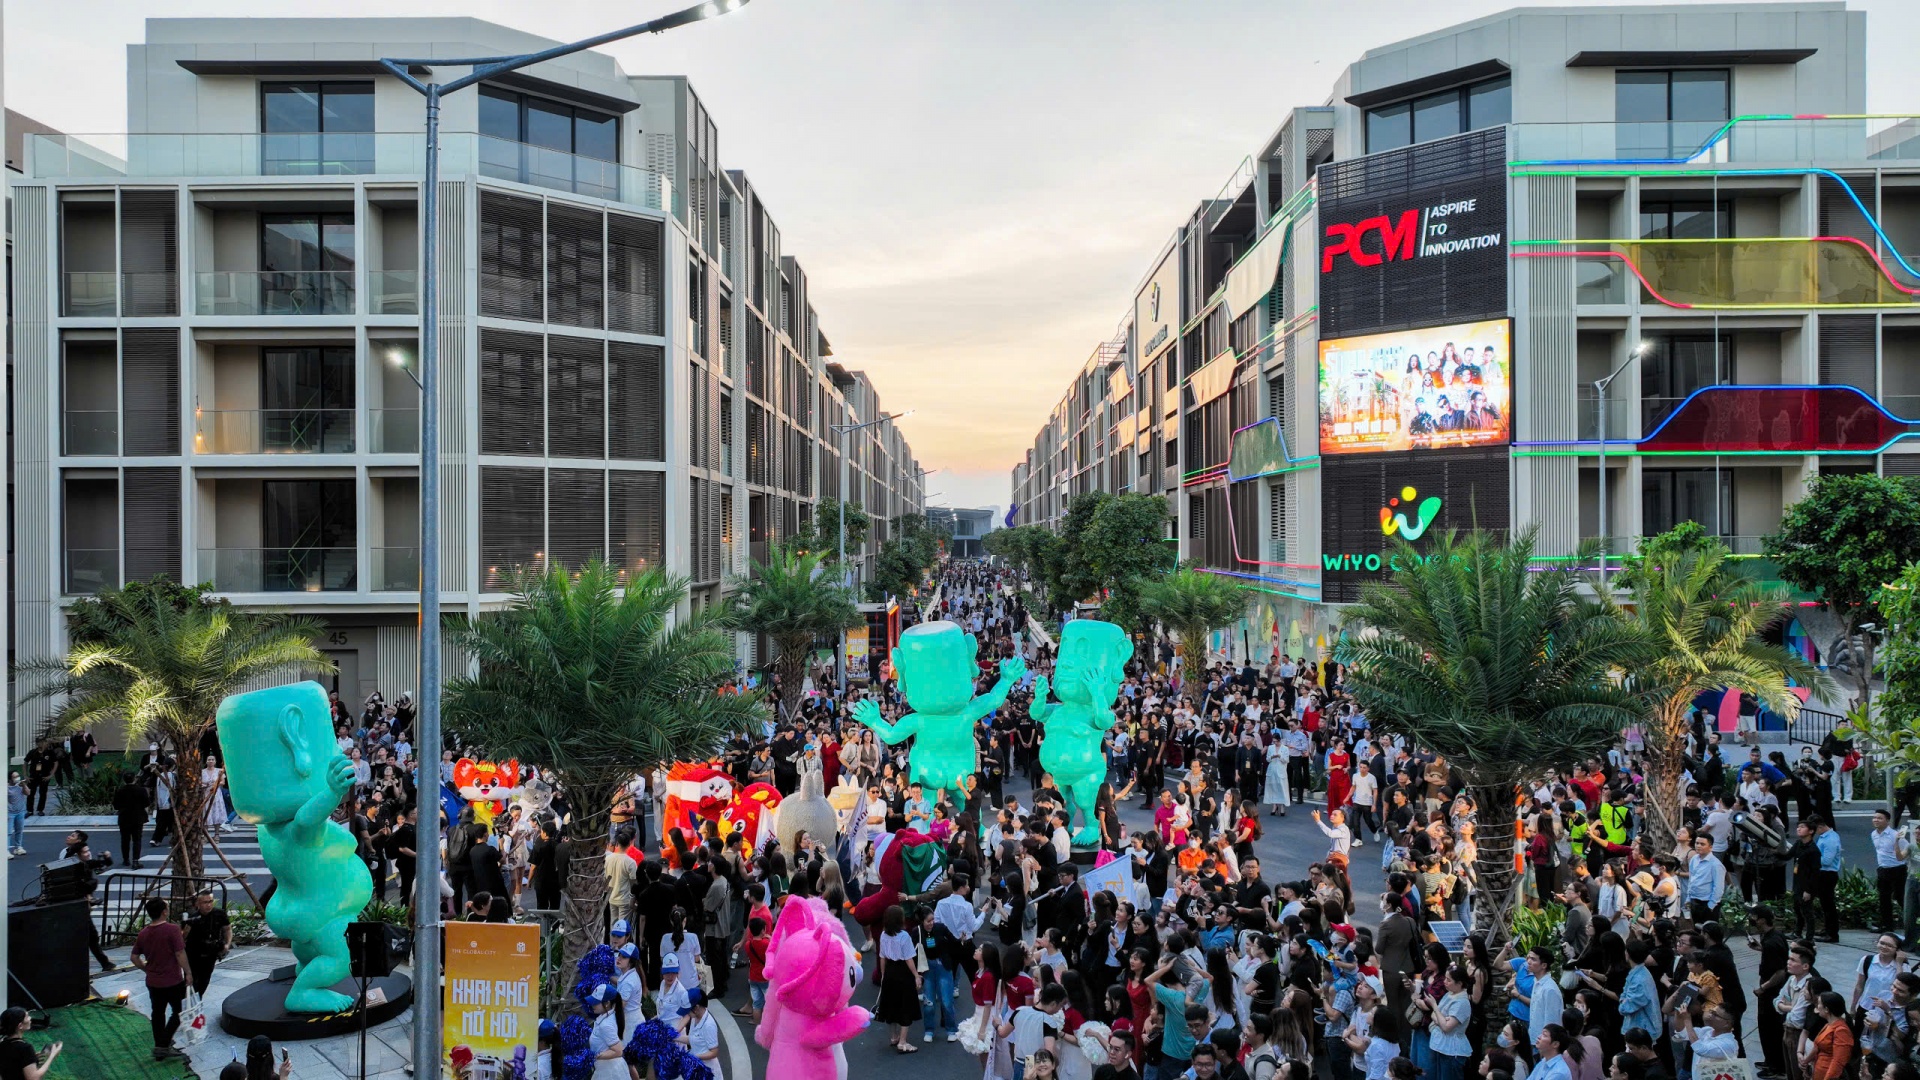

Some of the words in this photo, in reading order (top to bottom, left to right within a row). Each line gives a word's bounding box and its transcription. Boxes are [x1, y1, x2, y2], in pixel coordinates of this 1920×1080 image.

[1430, 199, 1477, 218] ASPIRE
[1429, 223, 1447, 236] TO
[1321, 209, 1419, 273] PCM
[1425, 234, 1500, 256] INNOVATION
[329, 631, 348, 645] 45
[452, 978, 491, 1006] KHAI
